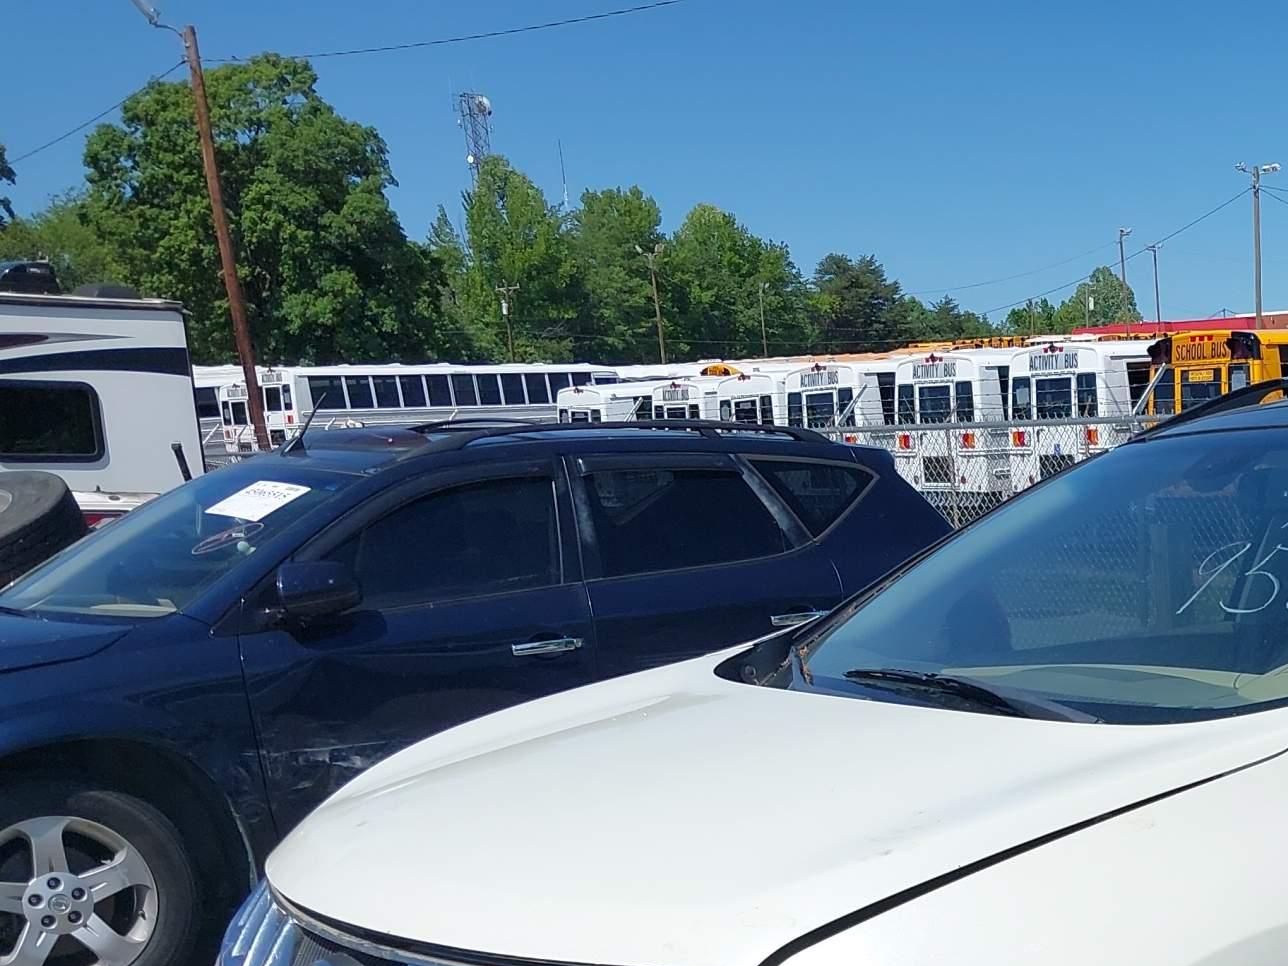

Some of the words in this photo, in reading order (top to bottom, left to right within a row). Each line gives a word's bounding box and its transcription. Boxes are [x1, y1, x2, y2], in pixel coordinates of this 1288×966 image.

[1175, 342, 1207, 361] SCHOOL
[1211, 341, 1227, 358] BUS
[912, 363, 939, 379] ACTIVITY
[943, 362, 957, 377] BUS
[1029, 354, 1059, 371] ACTIVITY
[1064, 353, 1079, 369] BUS
[800, 371, 823, 388] ACTIVITY
[827, 371, 839, 385] BUS
